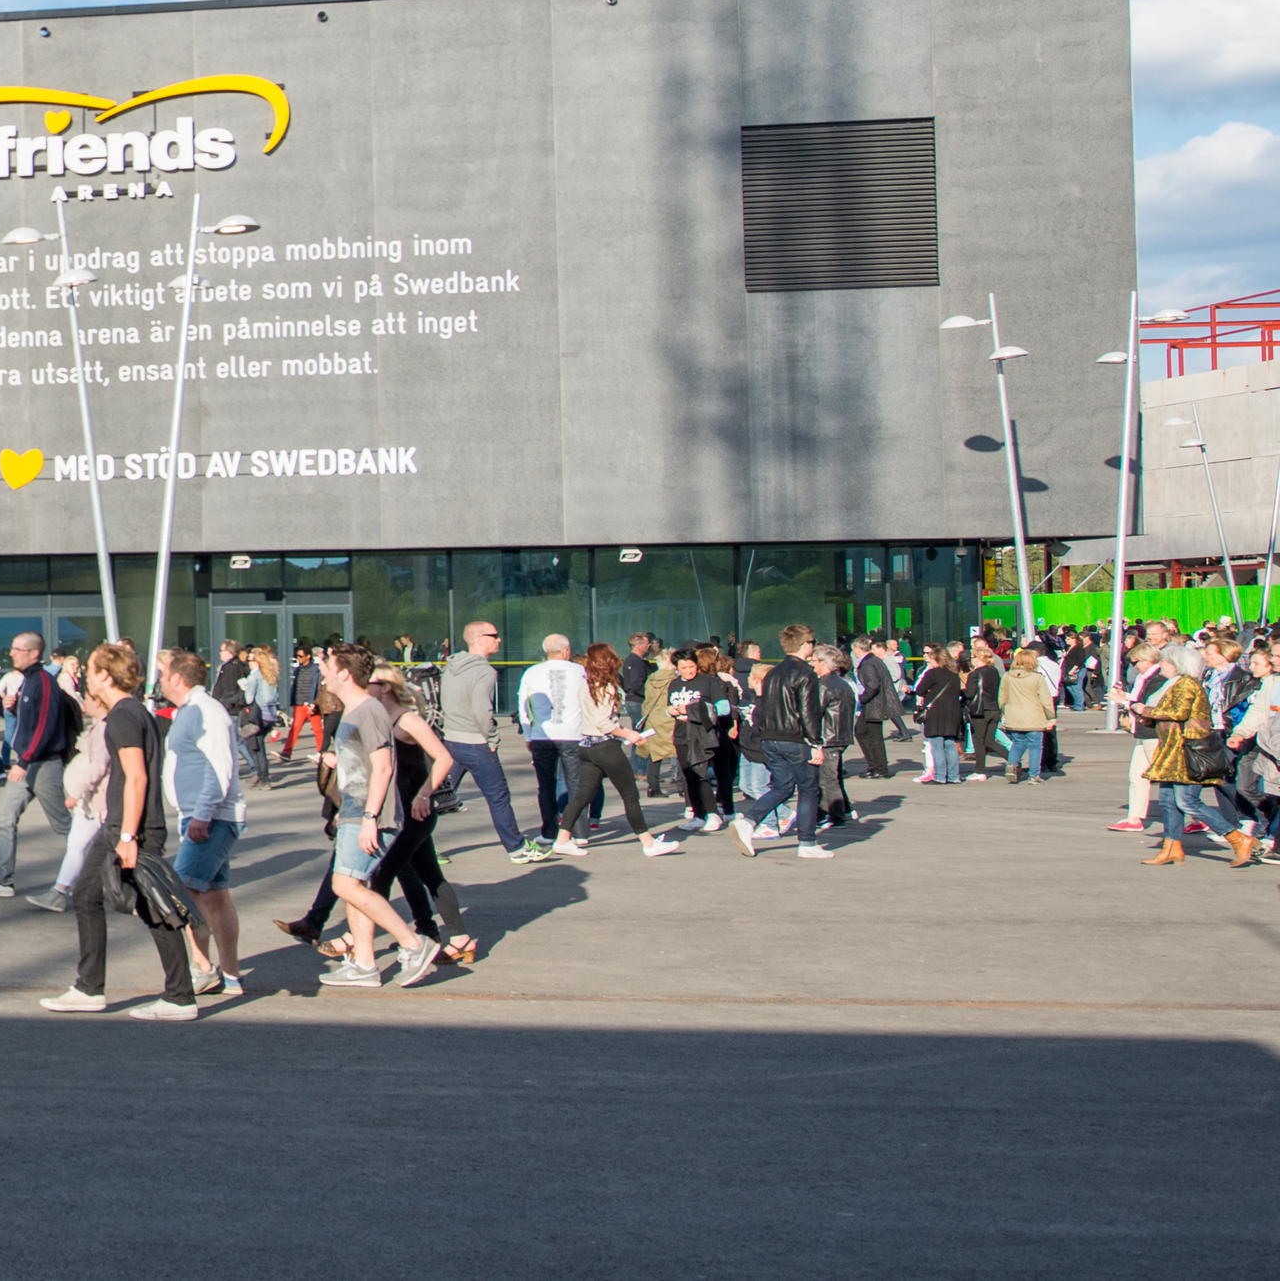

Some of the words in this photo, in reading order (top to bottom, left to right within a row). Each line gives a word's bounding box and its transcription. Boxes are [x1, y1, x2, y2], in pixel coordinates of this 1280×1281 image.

[49, 180, 173, 202] ARENA
[28, 249, 35, 272] i
[150, 242, 185, 267] att
[194, 241, 276, 269] stoppa
[285, 236, 402, 264] mobbning
[413, 233, 472, 256] inom
[45, 285, 81, 309] Ett
[89, 282, 166, 311] viktigt
[261, 281, 312, 300] som
[321, 275, 343, 299] vi
[354, 273, 384, 304] på
[393, 269, 520, 296] Swedbank
[149, 320, 176, 343] är
[185, 324, 213, 342] en
[222, 314, 362, 346] påminnelse
[371, 311, 407, 336] att
[417, 309, 479, 340] inget
[31, 360, 110, 387] utsatt,
[216, 355, 273, 379] eller
[281, 351, 379, 376] mobbat.
[54, 454, 115, 482] MED
[124, 445, 197, 481] STÖD
[205, 450, 242, 479] AV
[250, 446, 418, 478] SWEDBANK
